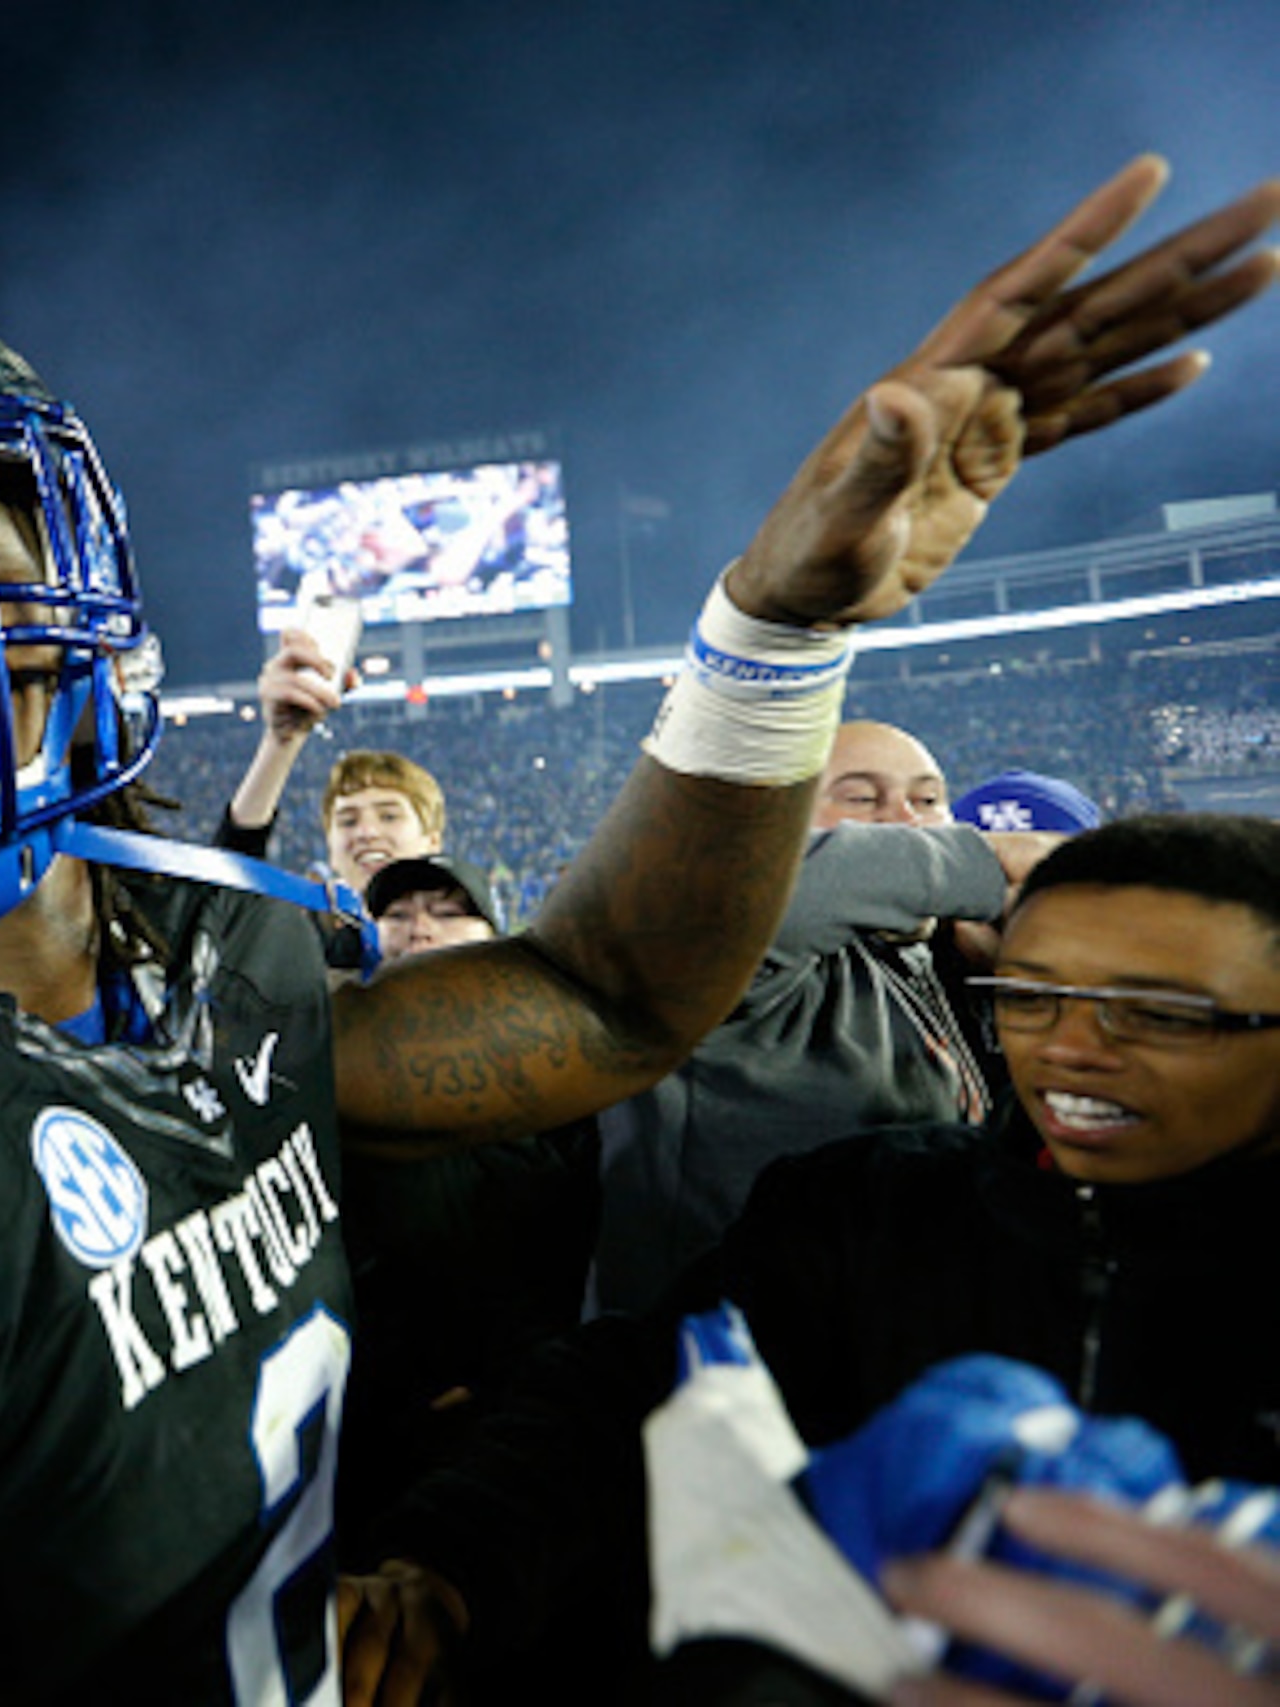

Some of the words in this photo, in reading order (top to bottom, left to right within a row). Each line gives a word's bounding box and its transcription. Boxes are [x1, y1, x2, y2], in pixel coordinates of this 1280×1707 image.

[704, 652, 820, 681] KENTU
[977, 800, 1034, 832] UK
[40, 1116, 144, 1255] SEC
[225, 1297, 352, 1707] 2
